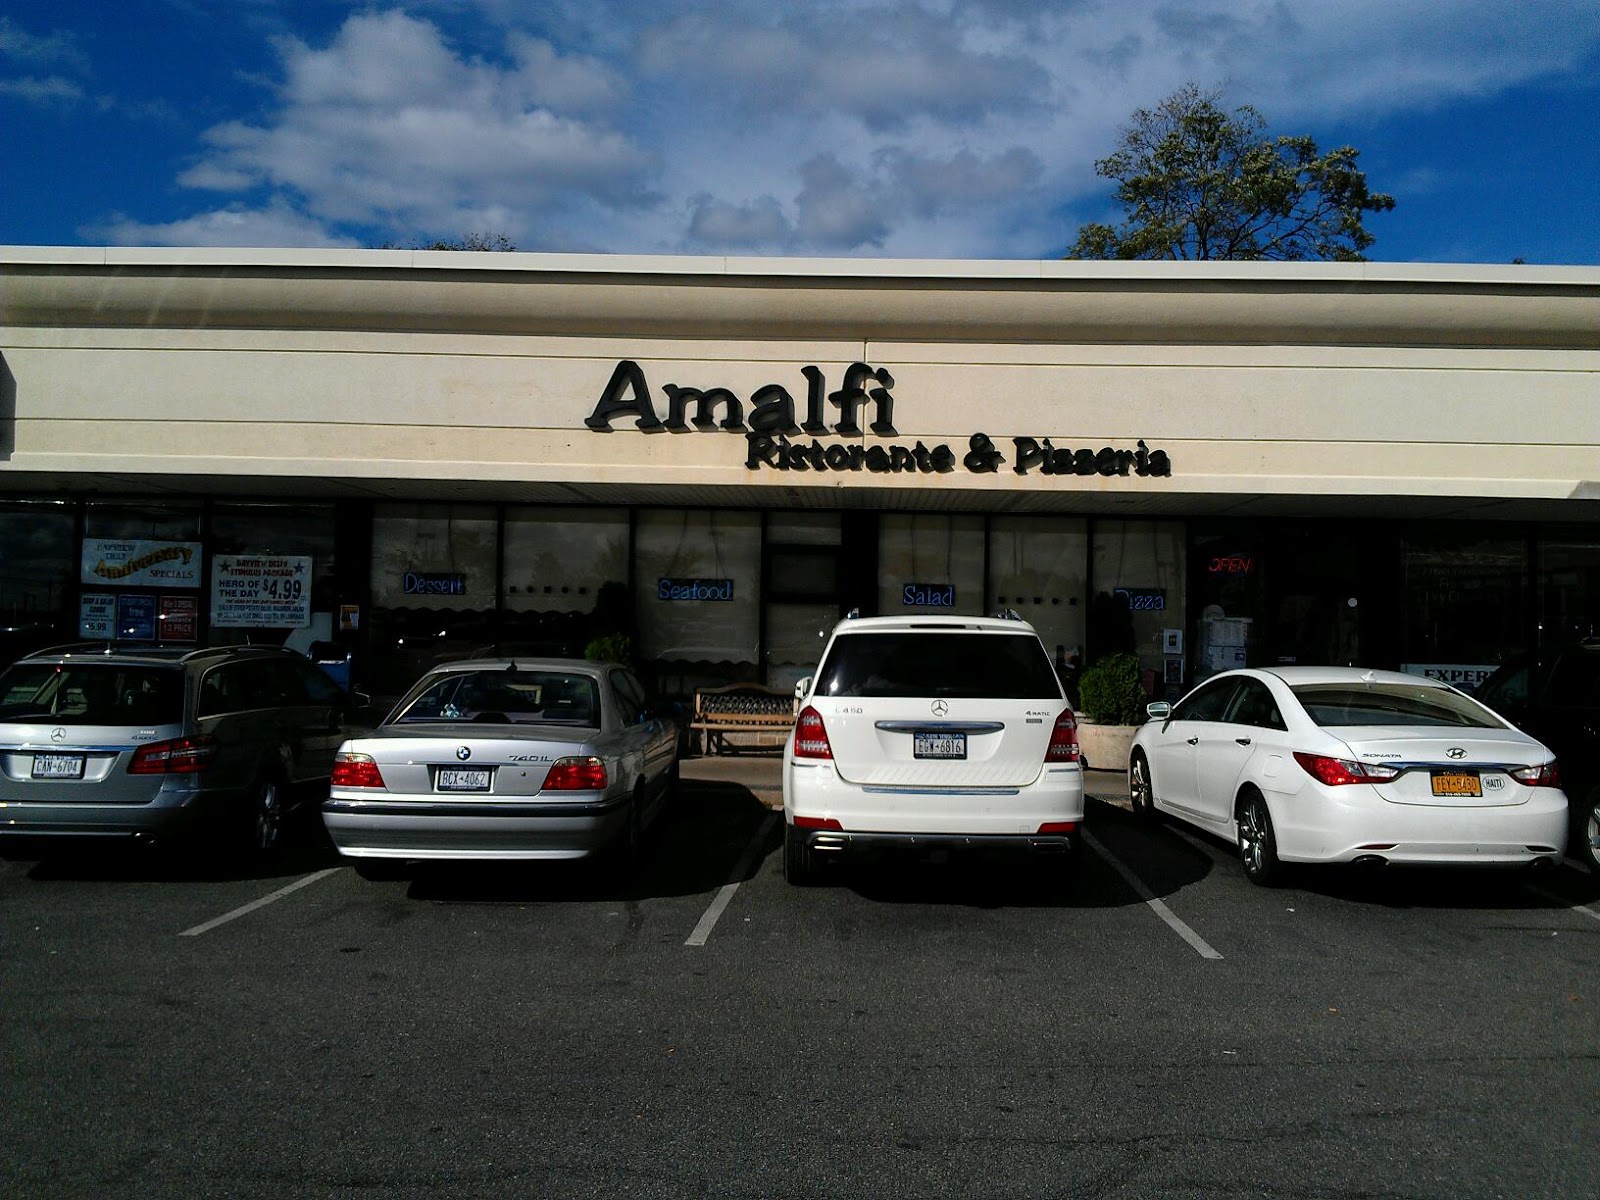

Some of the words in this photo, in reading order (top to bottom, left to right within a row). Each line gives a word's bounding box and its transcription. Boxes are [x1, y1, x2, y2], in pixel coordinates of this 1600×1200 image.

[584, 360, 898, 437] Amalfi
[745, 431, 955, 474] Ristorante
[963, 432, 1006, 473] &
[1012, 436, 1172, 477] Pizzeria
[150, 569, 194, 579] SPECIALS
[1208, 557, 1252, 573] OPEN
[219, 580, 245, 588] HERO
[248, 580, 260, 589] OF
[240, 590, 259, 598] DAY
[263, 579, 302, 600] $4.99
[403, 572, 465, 595] Dessert
[658, 579, 732, 600] Seafood
[903, 585, 955, 606] Salad
[1485, 778, 1503, 788] HAITI
